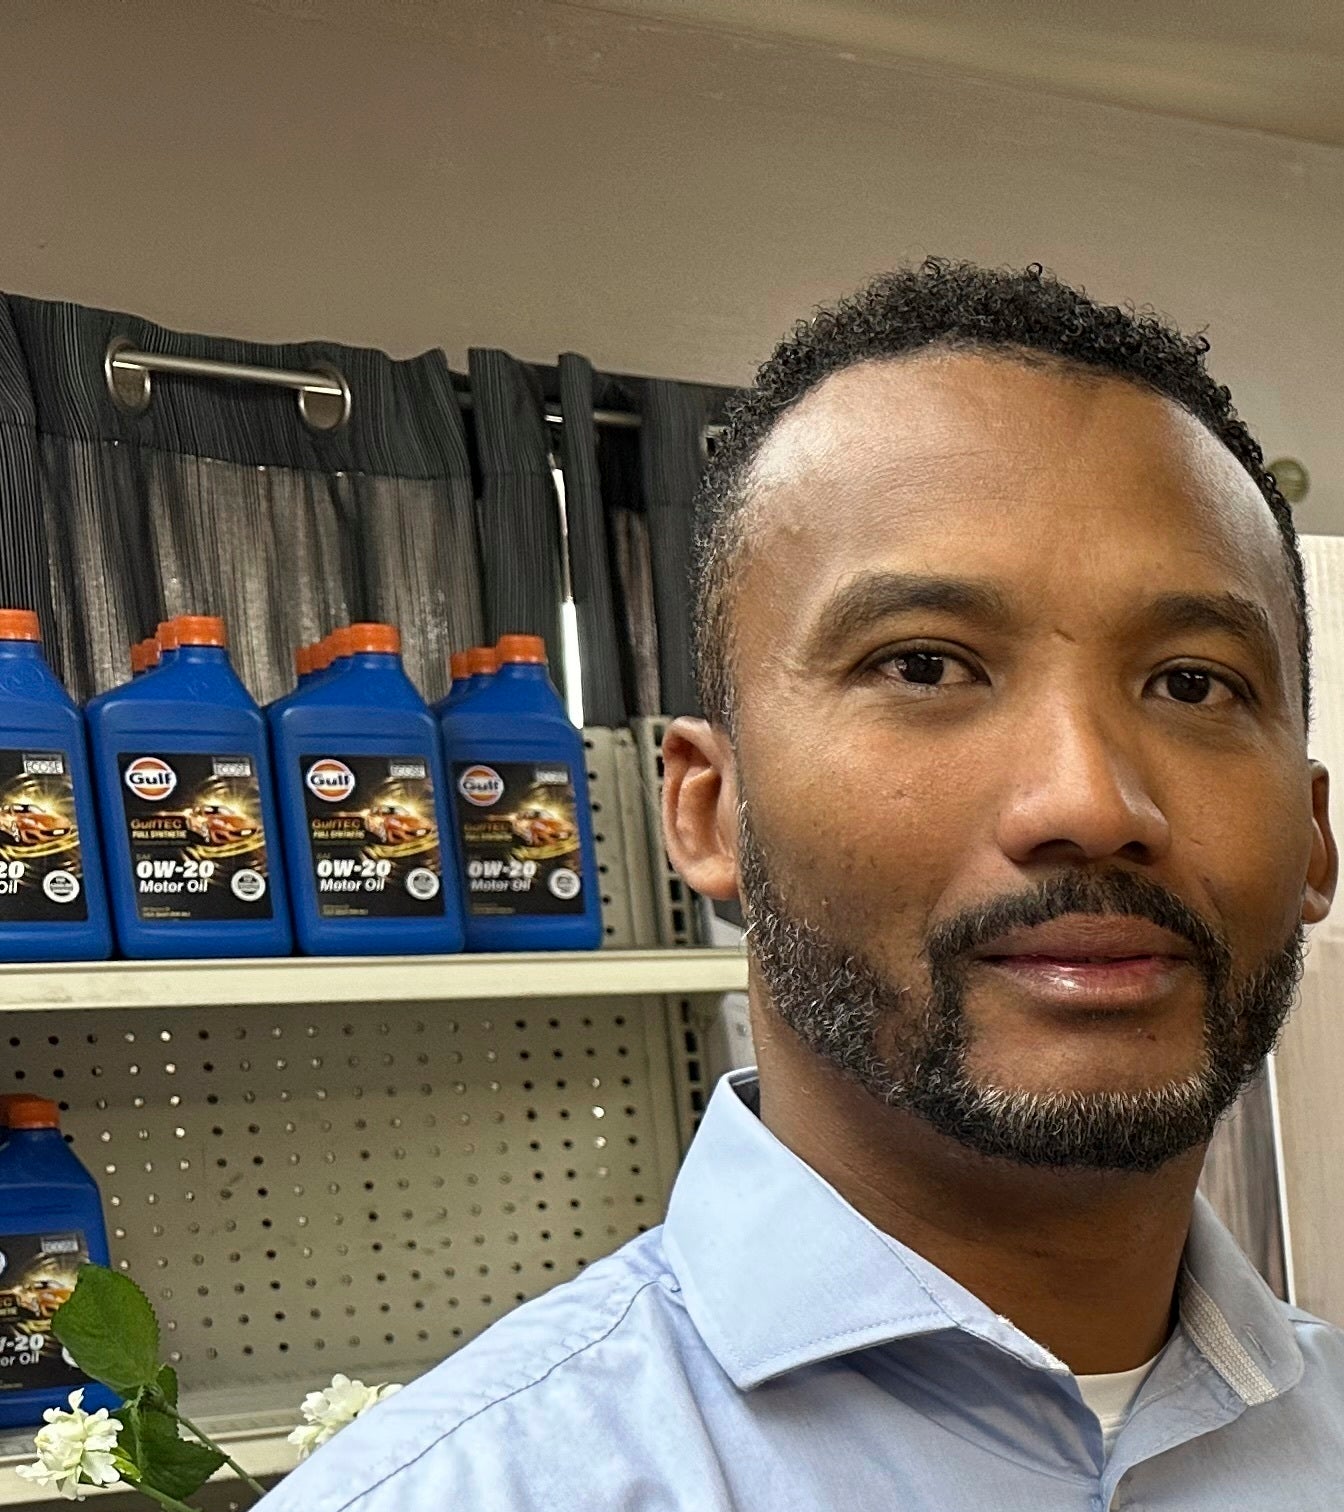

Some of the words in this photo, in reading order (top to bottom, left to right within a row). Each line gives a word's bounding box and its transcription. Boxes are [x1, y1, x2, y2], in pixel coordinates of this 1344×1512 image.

[129, 771, 173, 786] Gulf
[310, 773, 351, 787] Gulf
[136, 860, 215, 879] 0W-20
[316, 859, 392, 878] 0W-20
[139, 880, 184, 894] Motor
[187, 880, 209, 893] Oil
[319, 878, 363, 892] Motor
[365, 877, 385, 891] Oil
[19, 1351, 39, 1365] Oil
